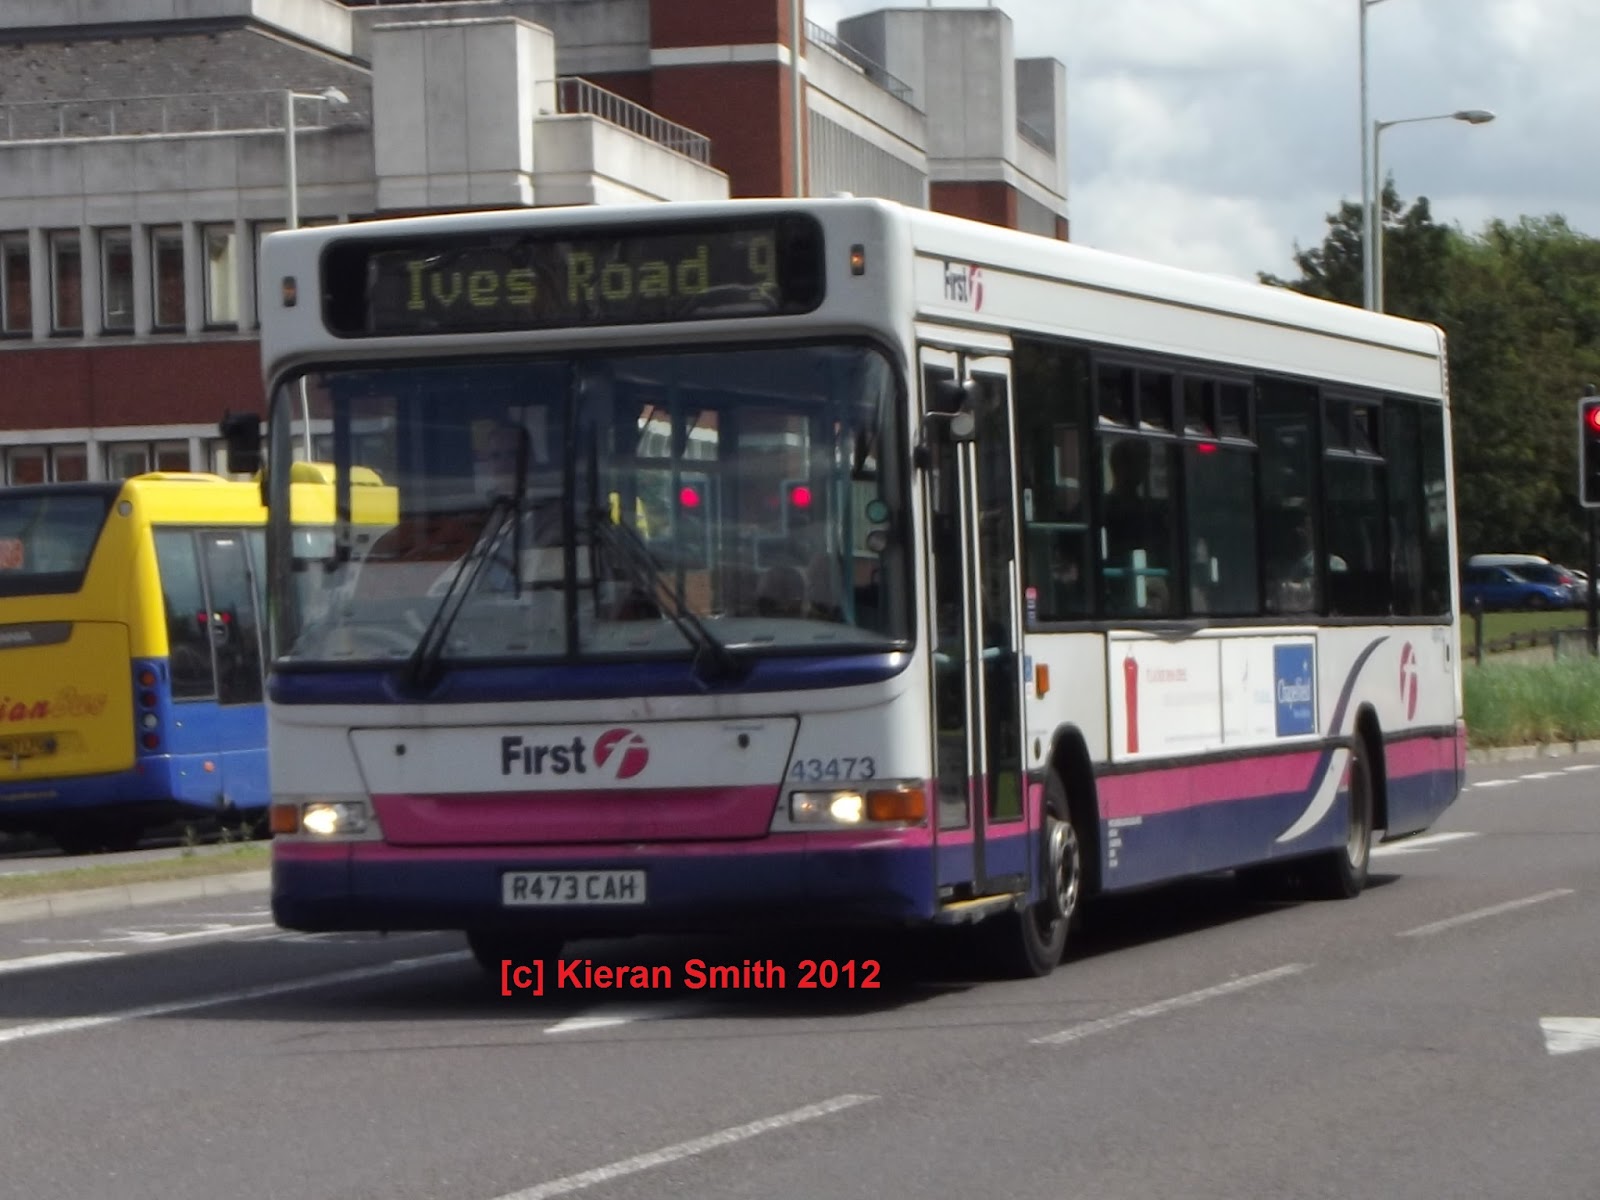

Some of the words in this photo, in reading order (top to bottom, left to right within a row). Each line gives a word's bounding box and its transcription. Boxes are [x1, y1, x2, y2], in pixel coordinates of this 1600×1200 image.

[407, 258, 537, 311] Ives
[568, 245, 708, 301] Road
[748, 235, 779, 301] 9
[501, 735, 586, 776] First
[791, 756, 876, 781] 43473
[511, 875, 579, 900] R473
[585, 873, 635, 899] CAH
